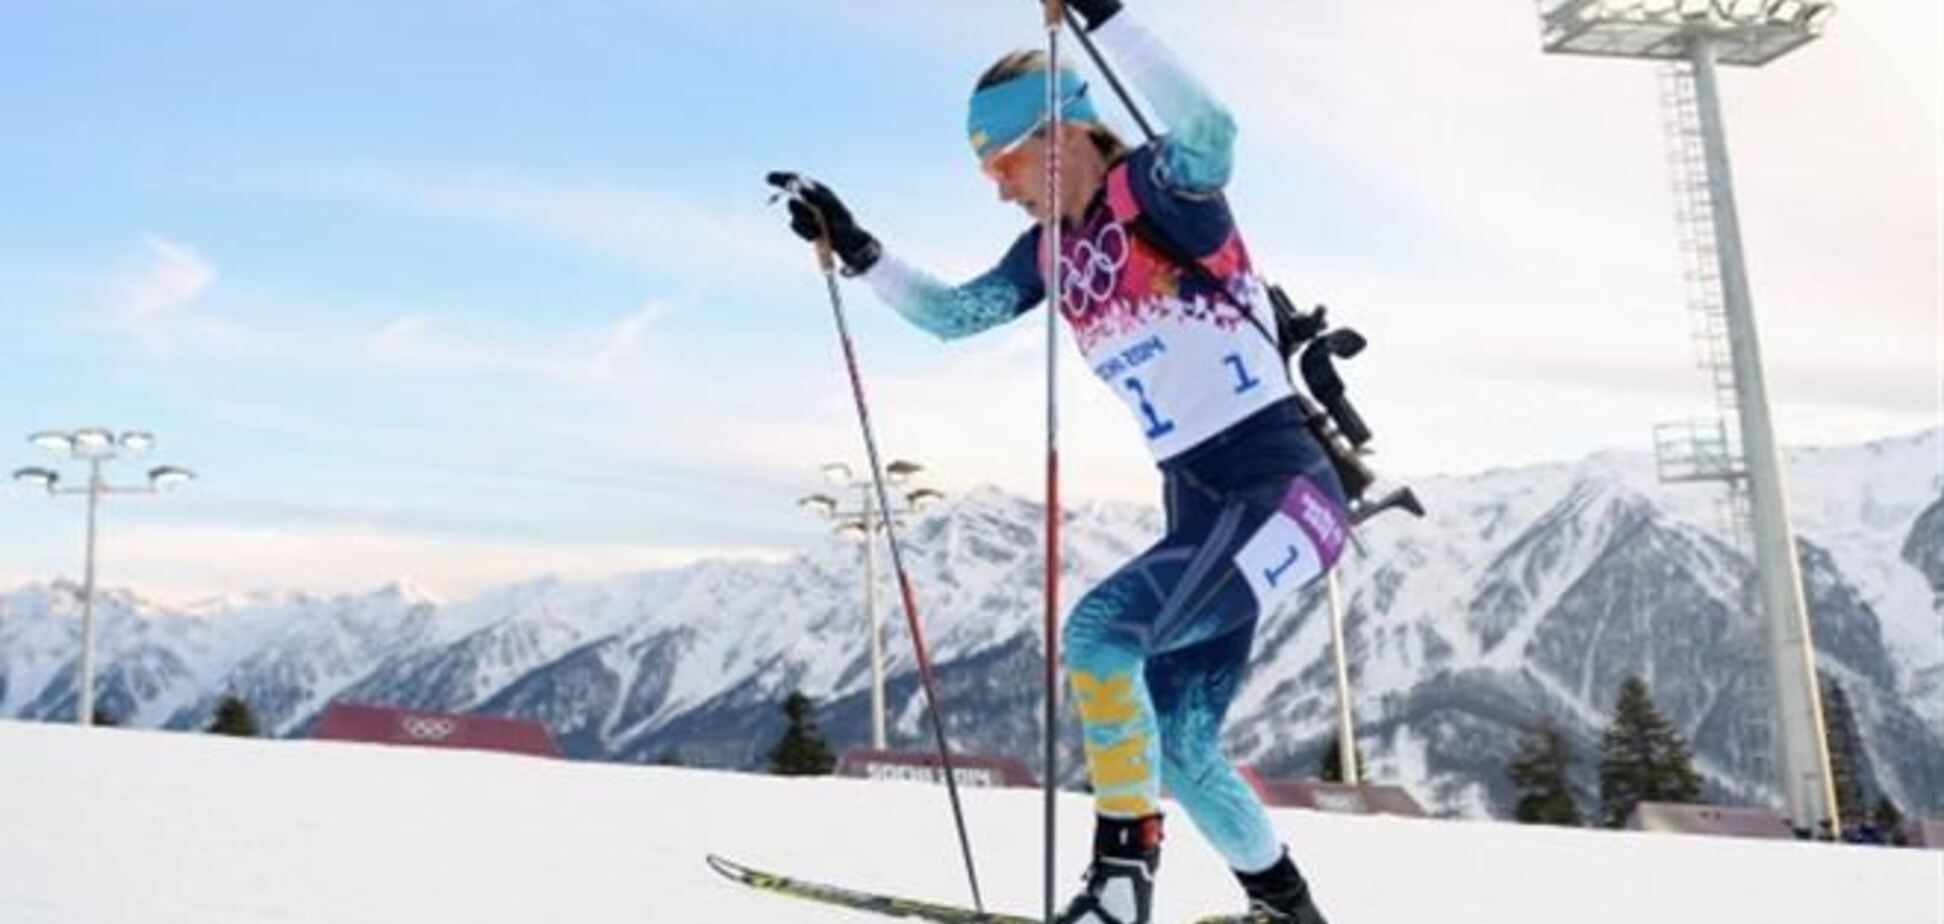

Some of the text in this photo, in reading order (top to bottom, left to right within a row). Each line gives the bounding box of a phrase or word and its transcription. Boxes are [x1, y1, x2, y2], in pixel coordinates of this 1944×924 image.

[1224, 354, 1259, 393] 1
[1125, 377, 1174, 439] 1
[1264, 544, 1299, 588] 1
